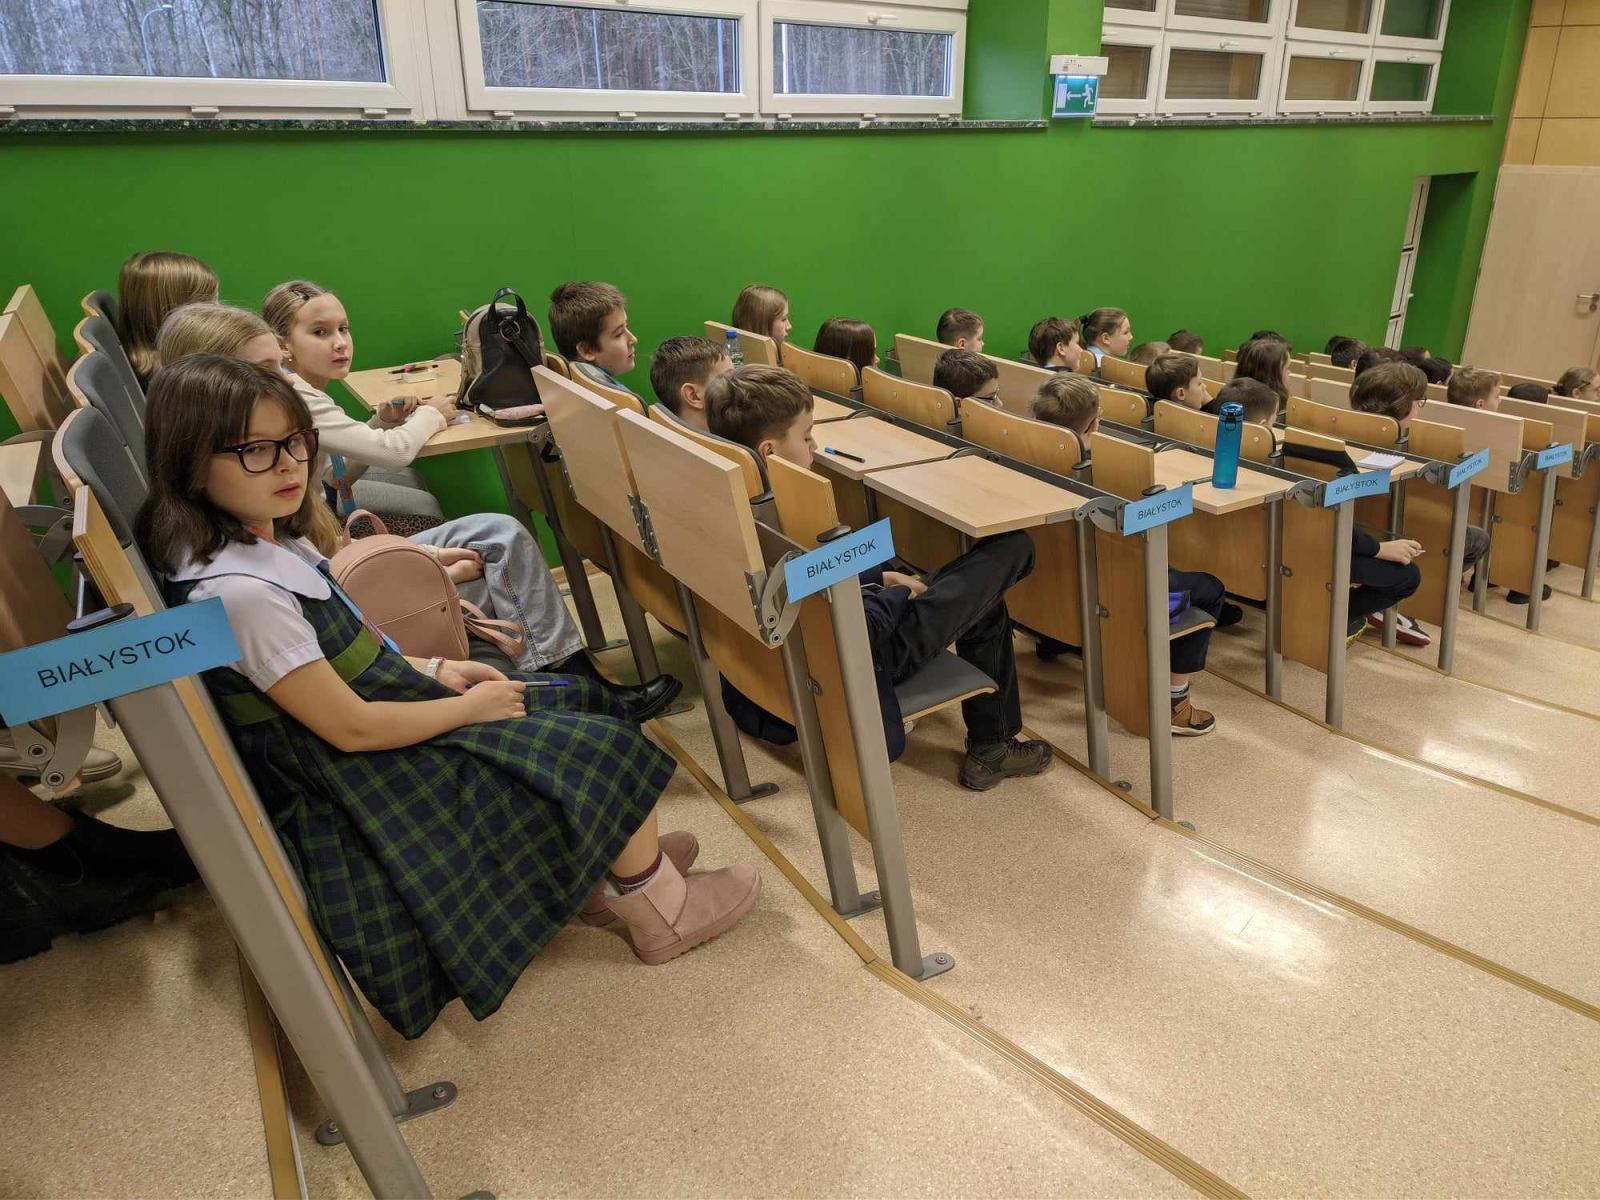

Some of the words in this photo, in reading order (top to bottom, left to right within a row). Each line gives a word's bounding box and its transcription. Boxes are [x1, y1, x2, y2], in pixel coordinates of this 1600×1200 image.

[1137, 498, 1182, 520] BIAŁYSTOK
[806, 539, 877, 579] BIAŁYSTOK
[37, 629, 197, 688] BIAŁYSTOK
